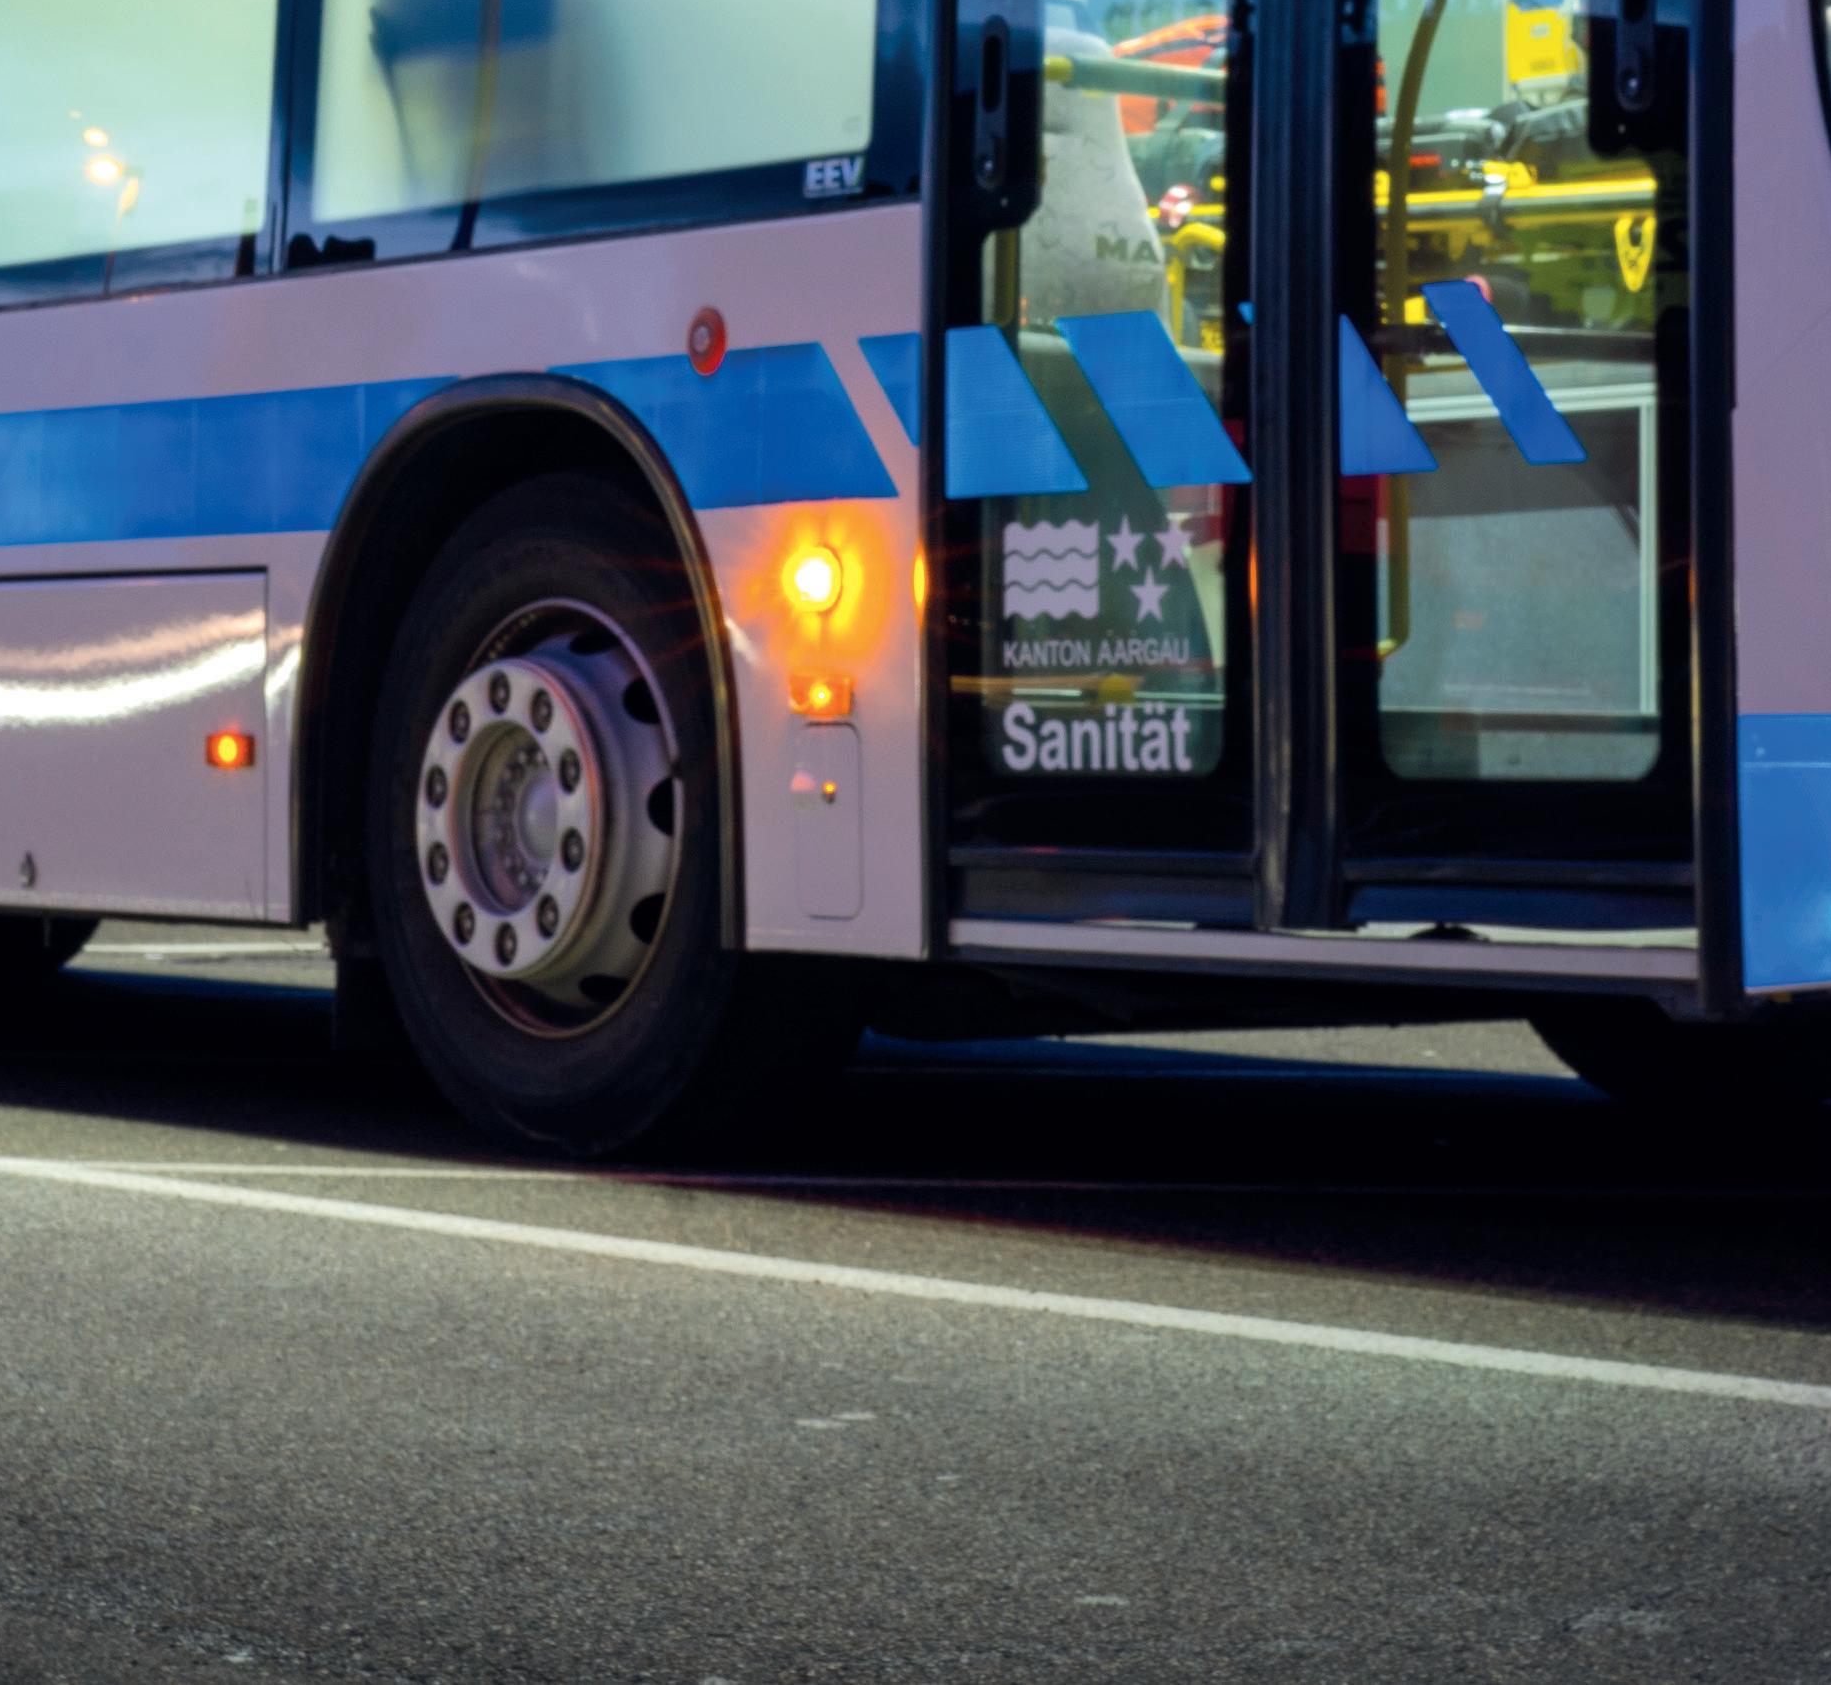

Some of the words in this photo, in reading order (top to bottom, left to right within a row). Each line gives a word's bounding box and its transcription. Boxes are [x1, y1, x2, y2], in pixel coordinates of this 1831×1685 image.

[804, 156, 865, 191] EEV
[1003, 639, 1091, 666] KANTON
[1097, 636, 1190, 665] AARGAU
[1002, 700, 1193, 772] Sanität
